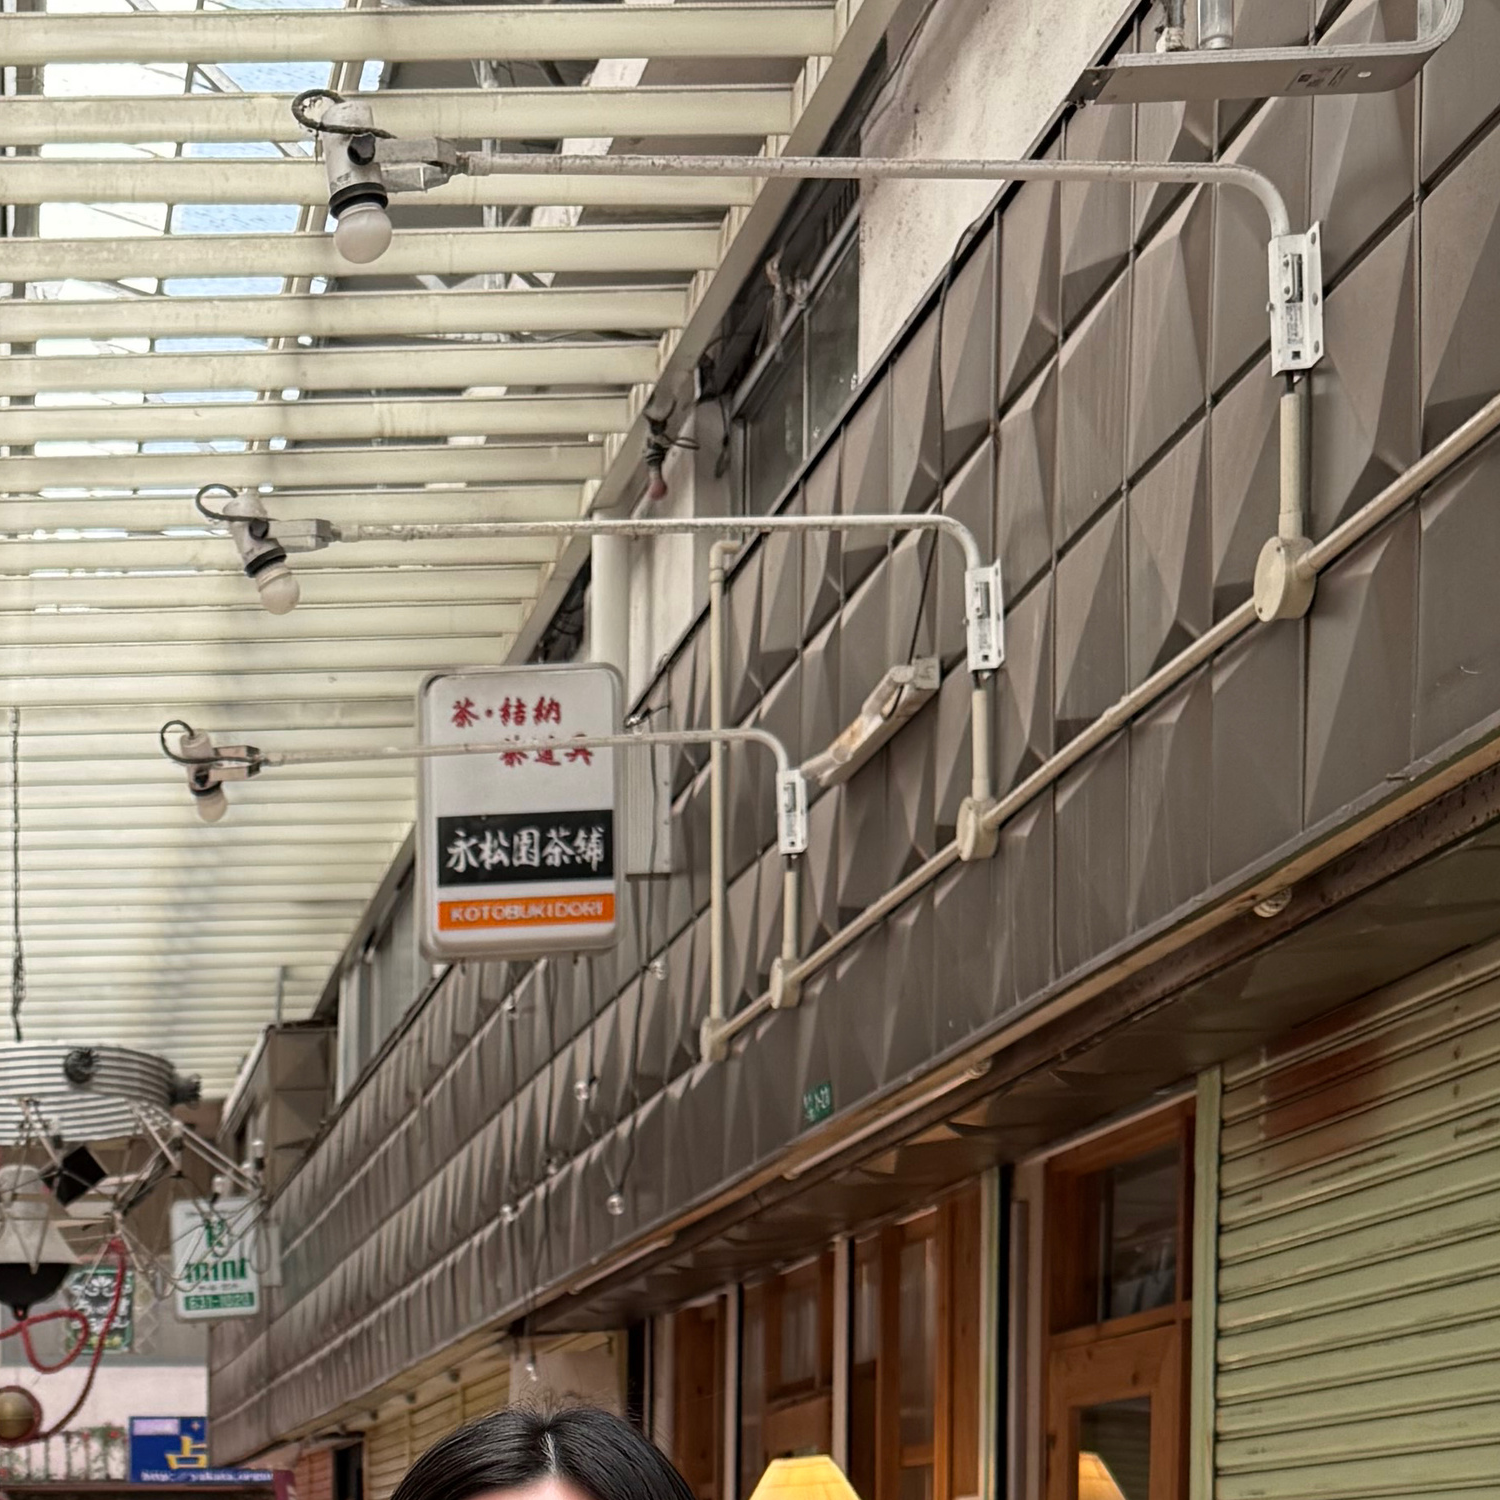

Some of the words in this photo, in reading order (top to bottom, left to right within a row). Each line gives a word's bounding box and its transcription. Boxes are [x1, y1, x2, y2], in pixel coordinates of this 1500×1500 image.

[451, 696, 562, 728] 茶・結納
[450, 900, 603, 923] KOTOBUKIDORI
